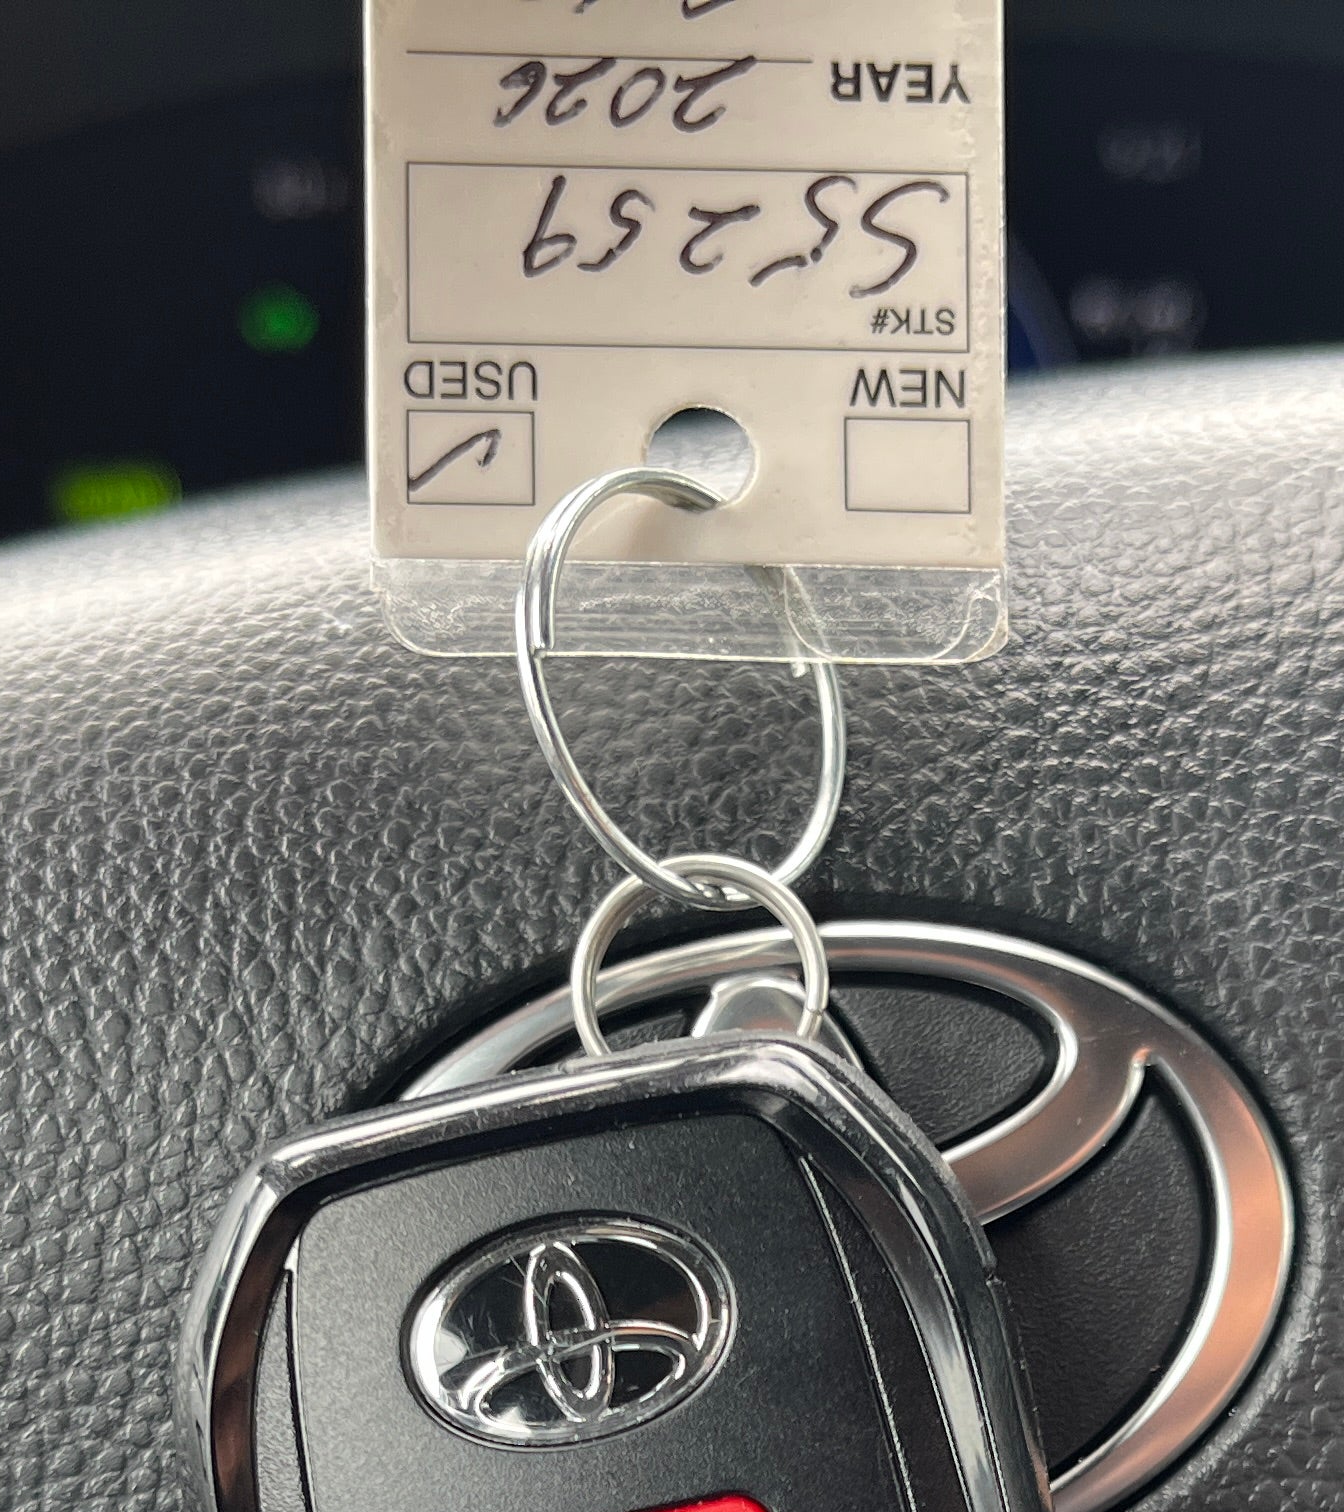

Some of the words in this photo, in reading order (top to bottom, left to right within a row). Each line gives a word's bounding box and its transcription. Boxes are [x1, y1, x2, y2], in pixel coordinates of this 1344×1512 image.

[493, 55, 756, 133] 2026
[830, 61, 971, 104] YEAR
[870, 307, 956, 336] STK#
[403, 360, 539, 402] USED
[849, 368, 967, 409] NEW
